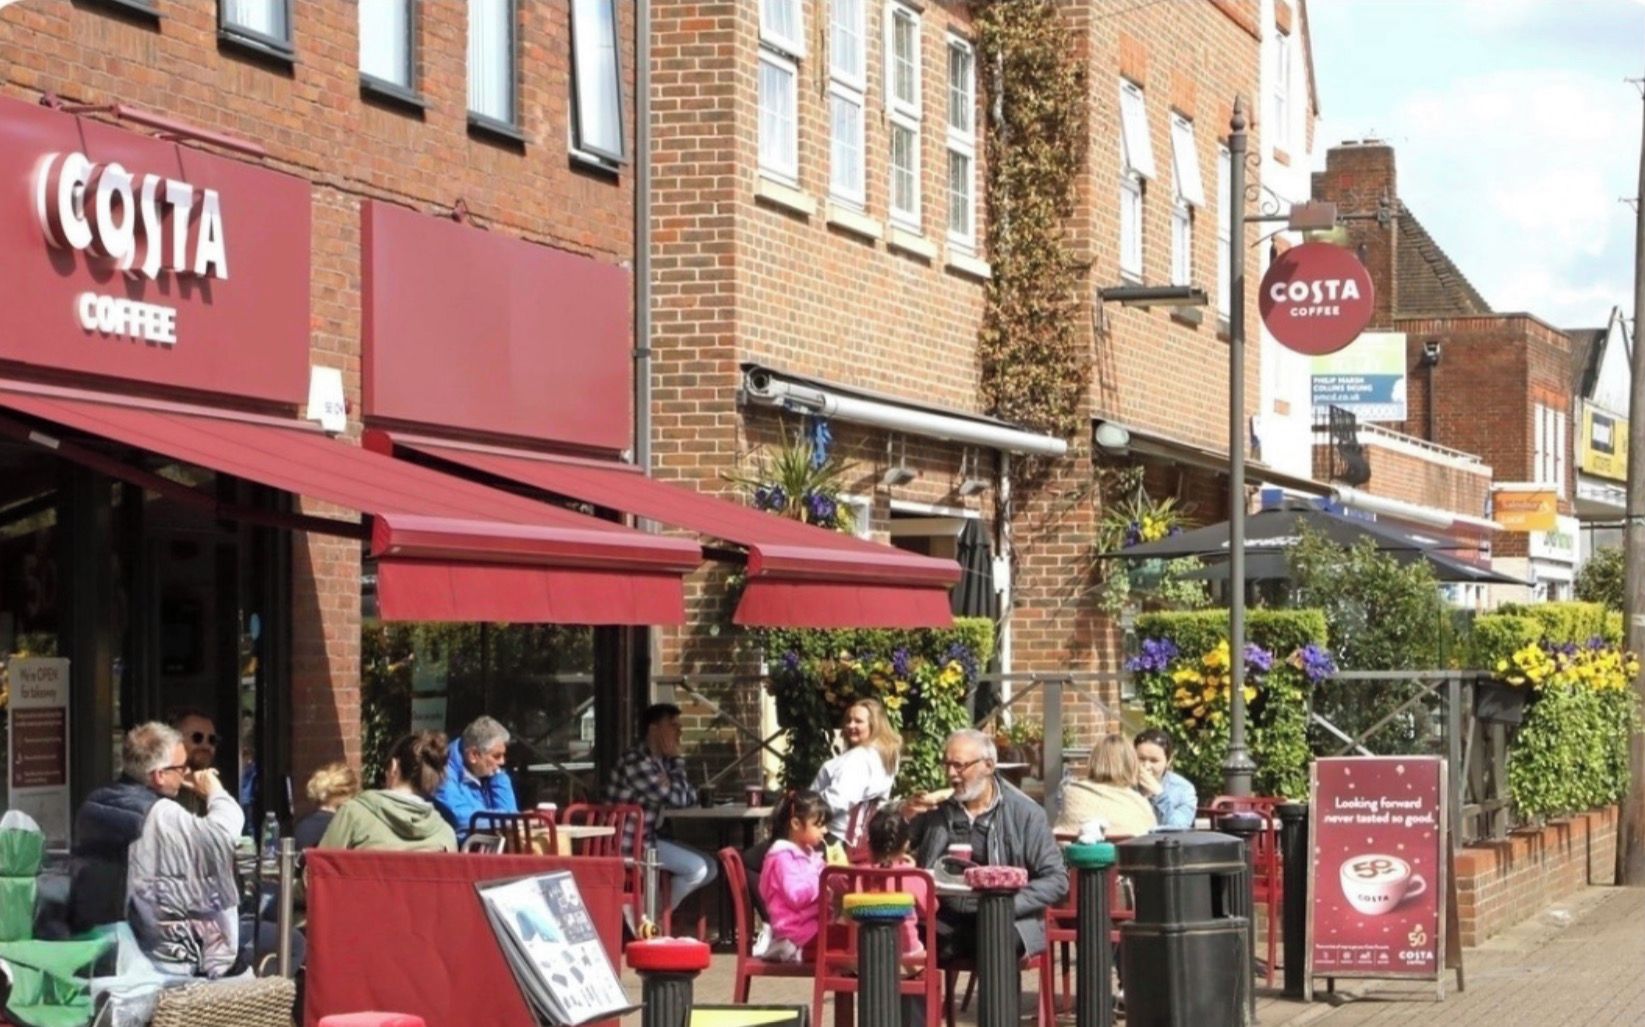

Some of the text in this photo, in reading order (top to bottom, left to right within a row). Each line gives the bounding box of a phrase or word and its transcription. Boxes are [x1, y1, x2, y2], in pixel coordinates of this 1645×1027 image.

[38, 151, 228, 280] COSTA
[1269, 279, 1360, 304] COSTA
[78, 292, 177, 344] COFFEE
[1290, 306, 1340, 316] COFFEE
[1335, 796, 1422, 812] Looking forward
[1324, 812, 1435, 827] never tasted so good.
[1358, 894, 1389, 902] COSTA
[1408, 931, 1427, 947] 50
[1398, 950, 1434, 962] COSTA
